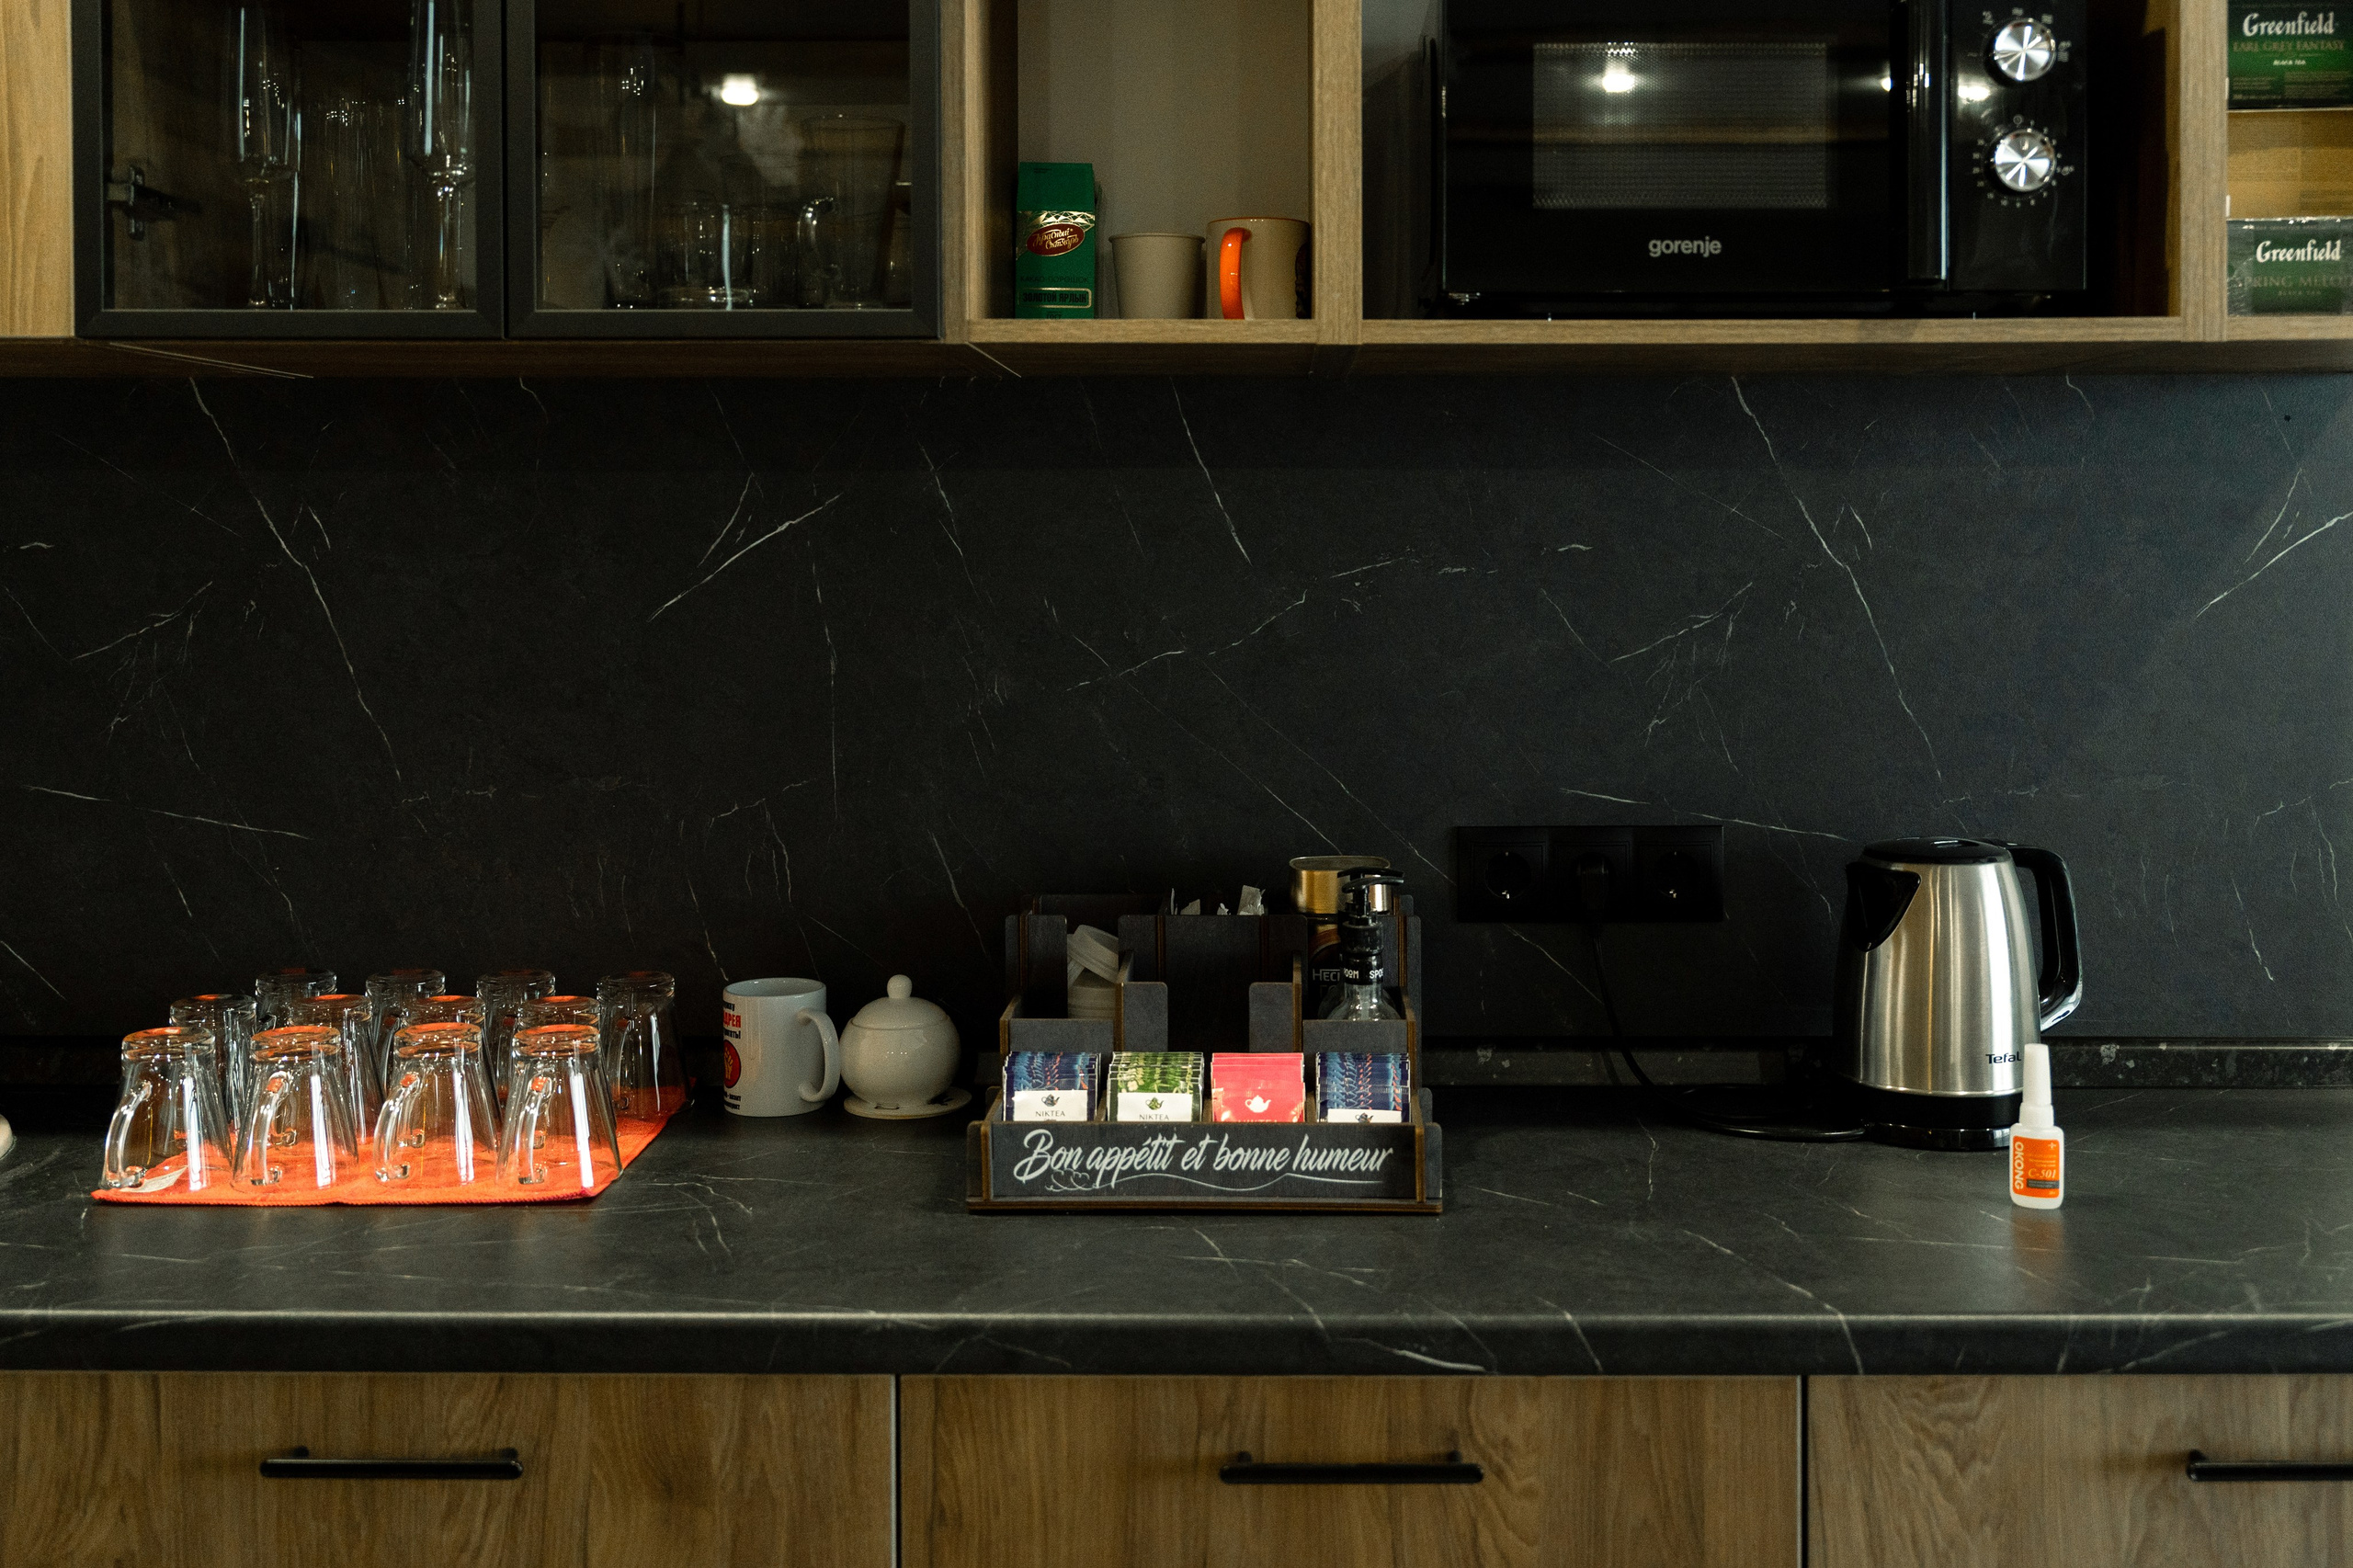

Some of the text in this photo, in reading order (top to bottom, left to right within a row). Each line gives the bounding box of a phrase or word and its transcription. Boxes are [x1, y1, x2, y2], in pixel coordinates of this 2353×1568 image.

[2242, 10, 2336, 37] Greenfield
[1648, 235, 1722, 257] gorenje
[2256, 238, 2342, 263] Greenfield
[1023, 291, 1086, 303] ЗОЛОТОЙ ЯРЛЫК
[1985, 1051, 2022, 1064] Tefal
[1013, 1128, 1083, 1184] Bon
[1181, 1132, 1219, 1172] et
[1212, 1132, 1290, 1172] bonne
[1292, 1133, 1393, 1172] humeur
[2014, 1141, 2025, 1190] OKONG
[2028, 1168, 2057, 1179] C-501
